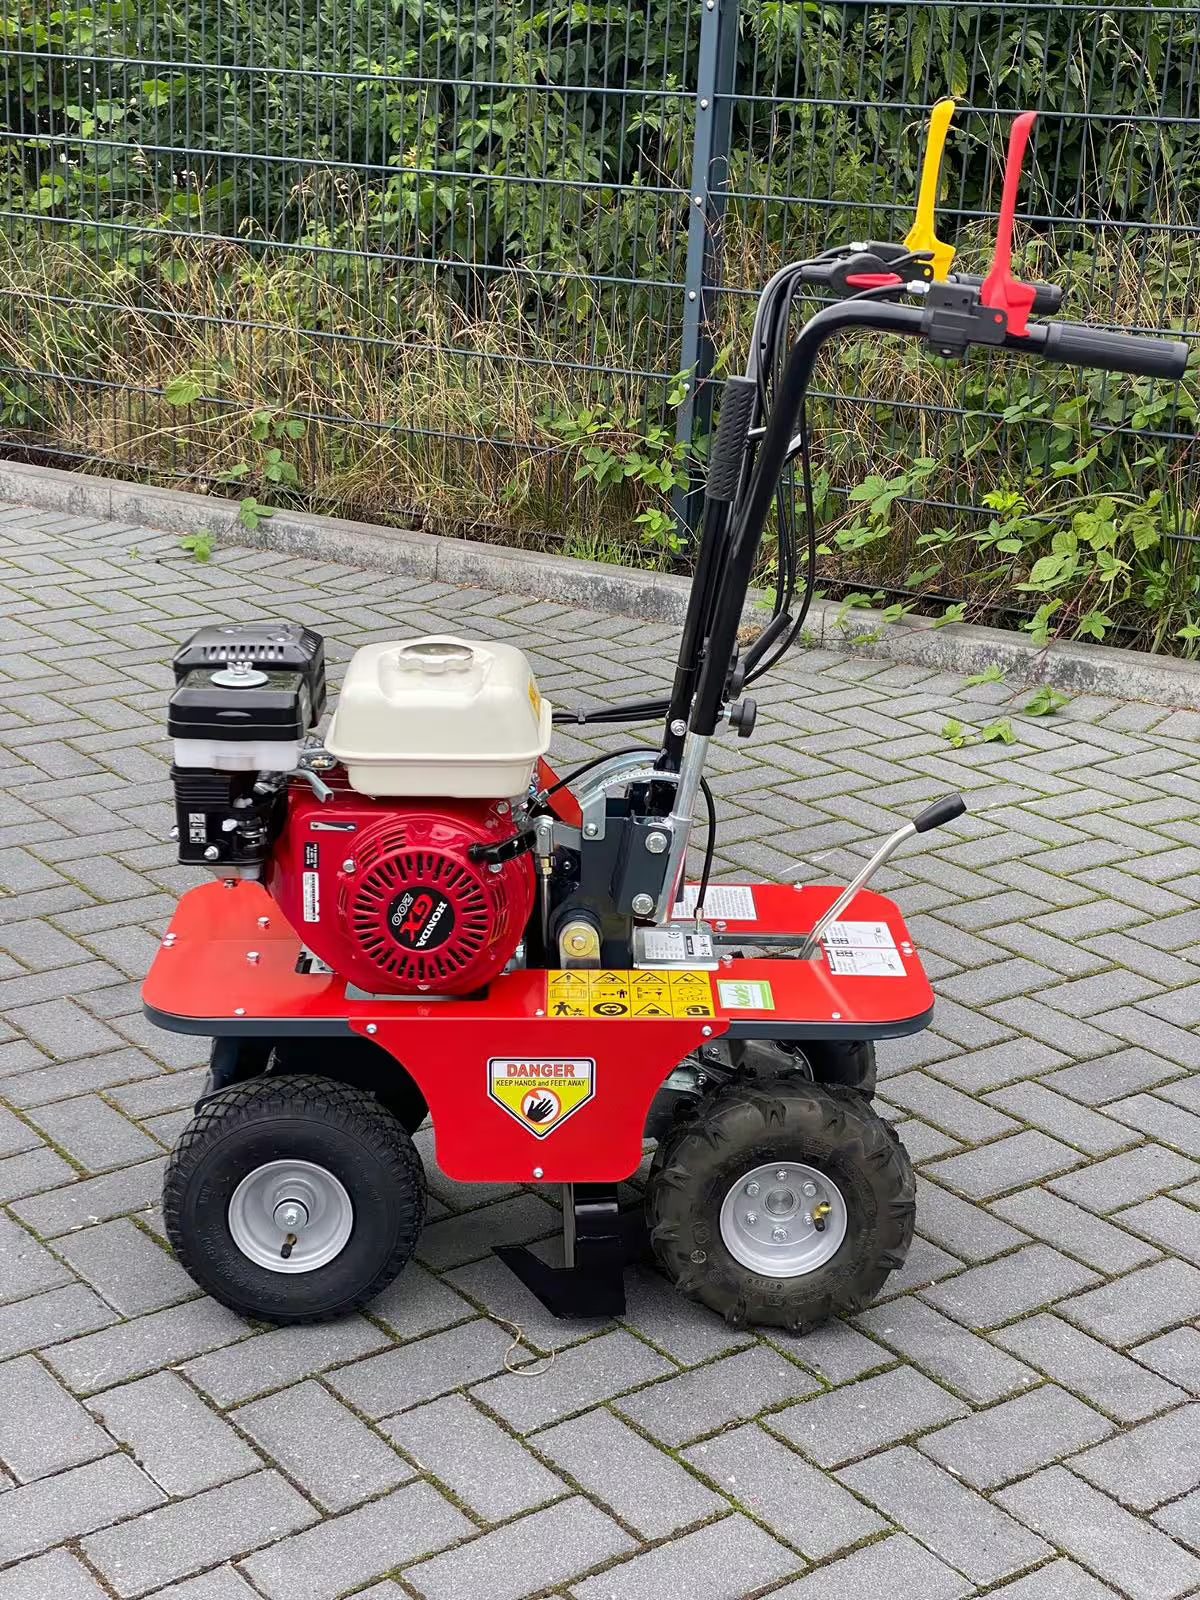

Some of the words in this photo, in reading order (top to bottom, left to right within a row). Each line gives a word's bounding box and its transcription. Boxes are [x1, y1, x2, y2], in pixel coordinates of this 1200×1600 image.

[391, 893, 414, 926] 200
[400, 894, 433, 942] GX
[416, 901, 447, 947] HONDA
[496, 1079, 514, 1087] KEEP
[514, 1079, 537, 1087] HANDS
[537, 1079, 549, 1087] and
[550, 1079, 566, 1087] FEET
[567, 1079, 586, 1087] AWAY
[506, 1063, 576, 1078] DANGER
